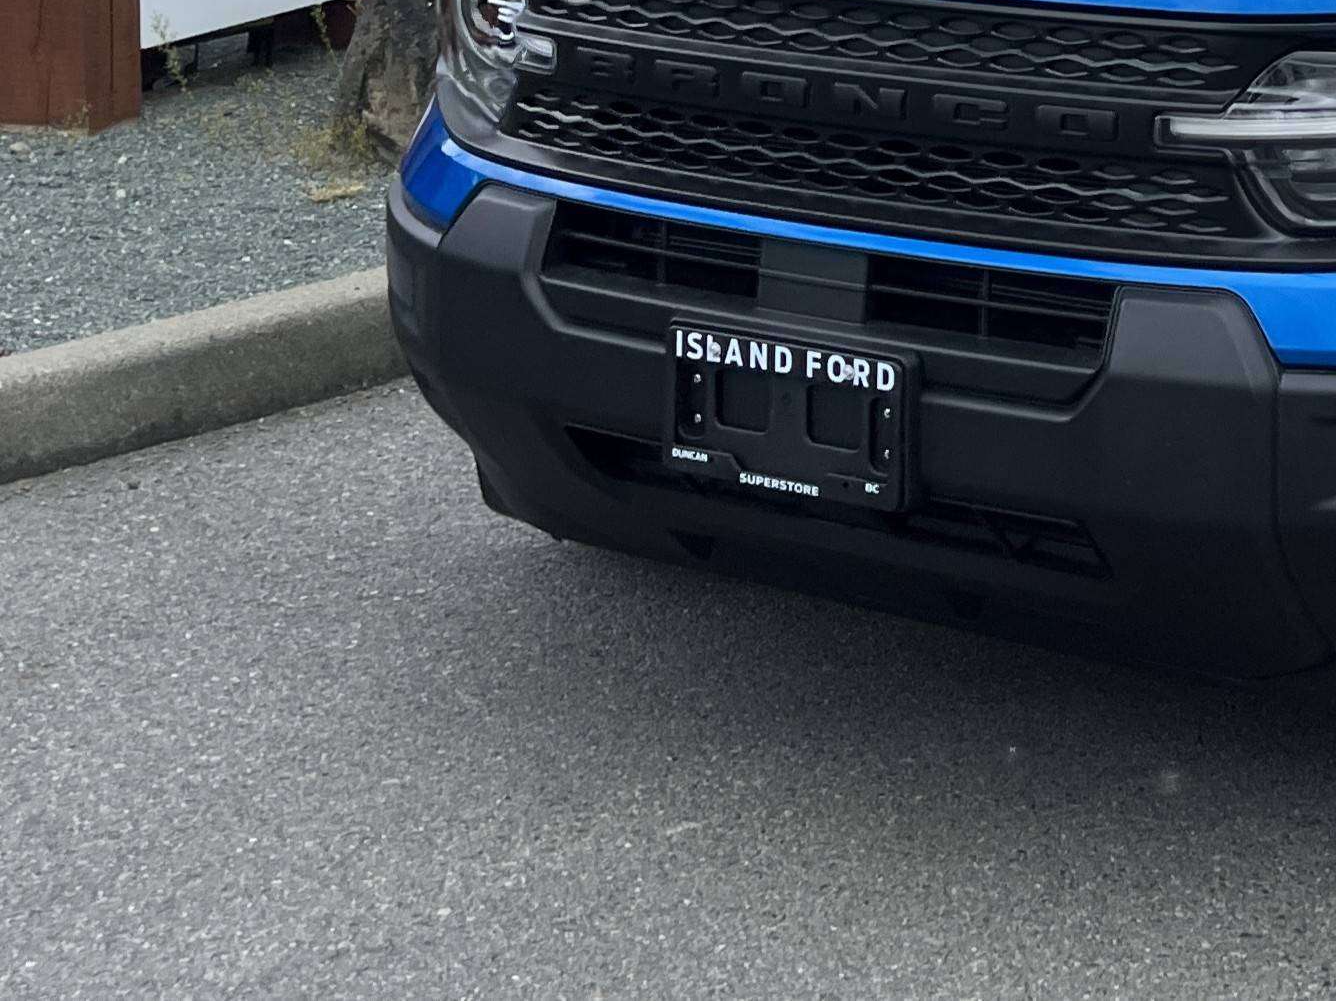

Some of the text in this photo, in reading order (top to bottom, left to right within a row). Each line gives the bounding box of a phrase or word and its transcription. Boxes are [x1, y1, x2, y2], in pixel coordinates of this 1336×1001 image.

[576, 46, 1117, 139] BRONCO
[675, 330, 895, 391] ISLAND FORD
[671, 447, 708, 462] DUNCAN
[739, 472, 819, 496] SUPERSTORE
